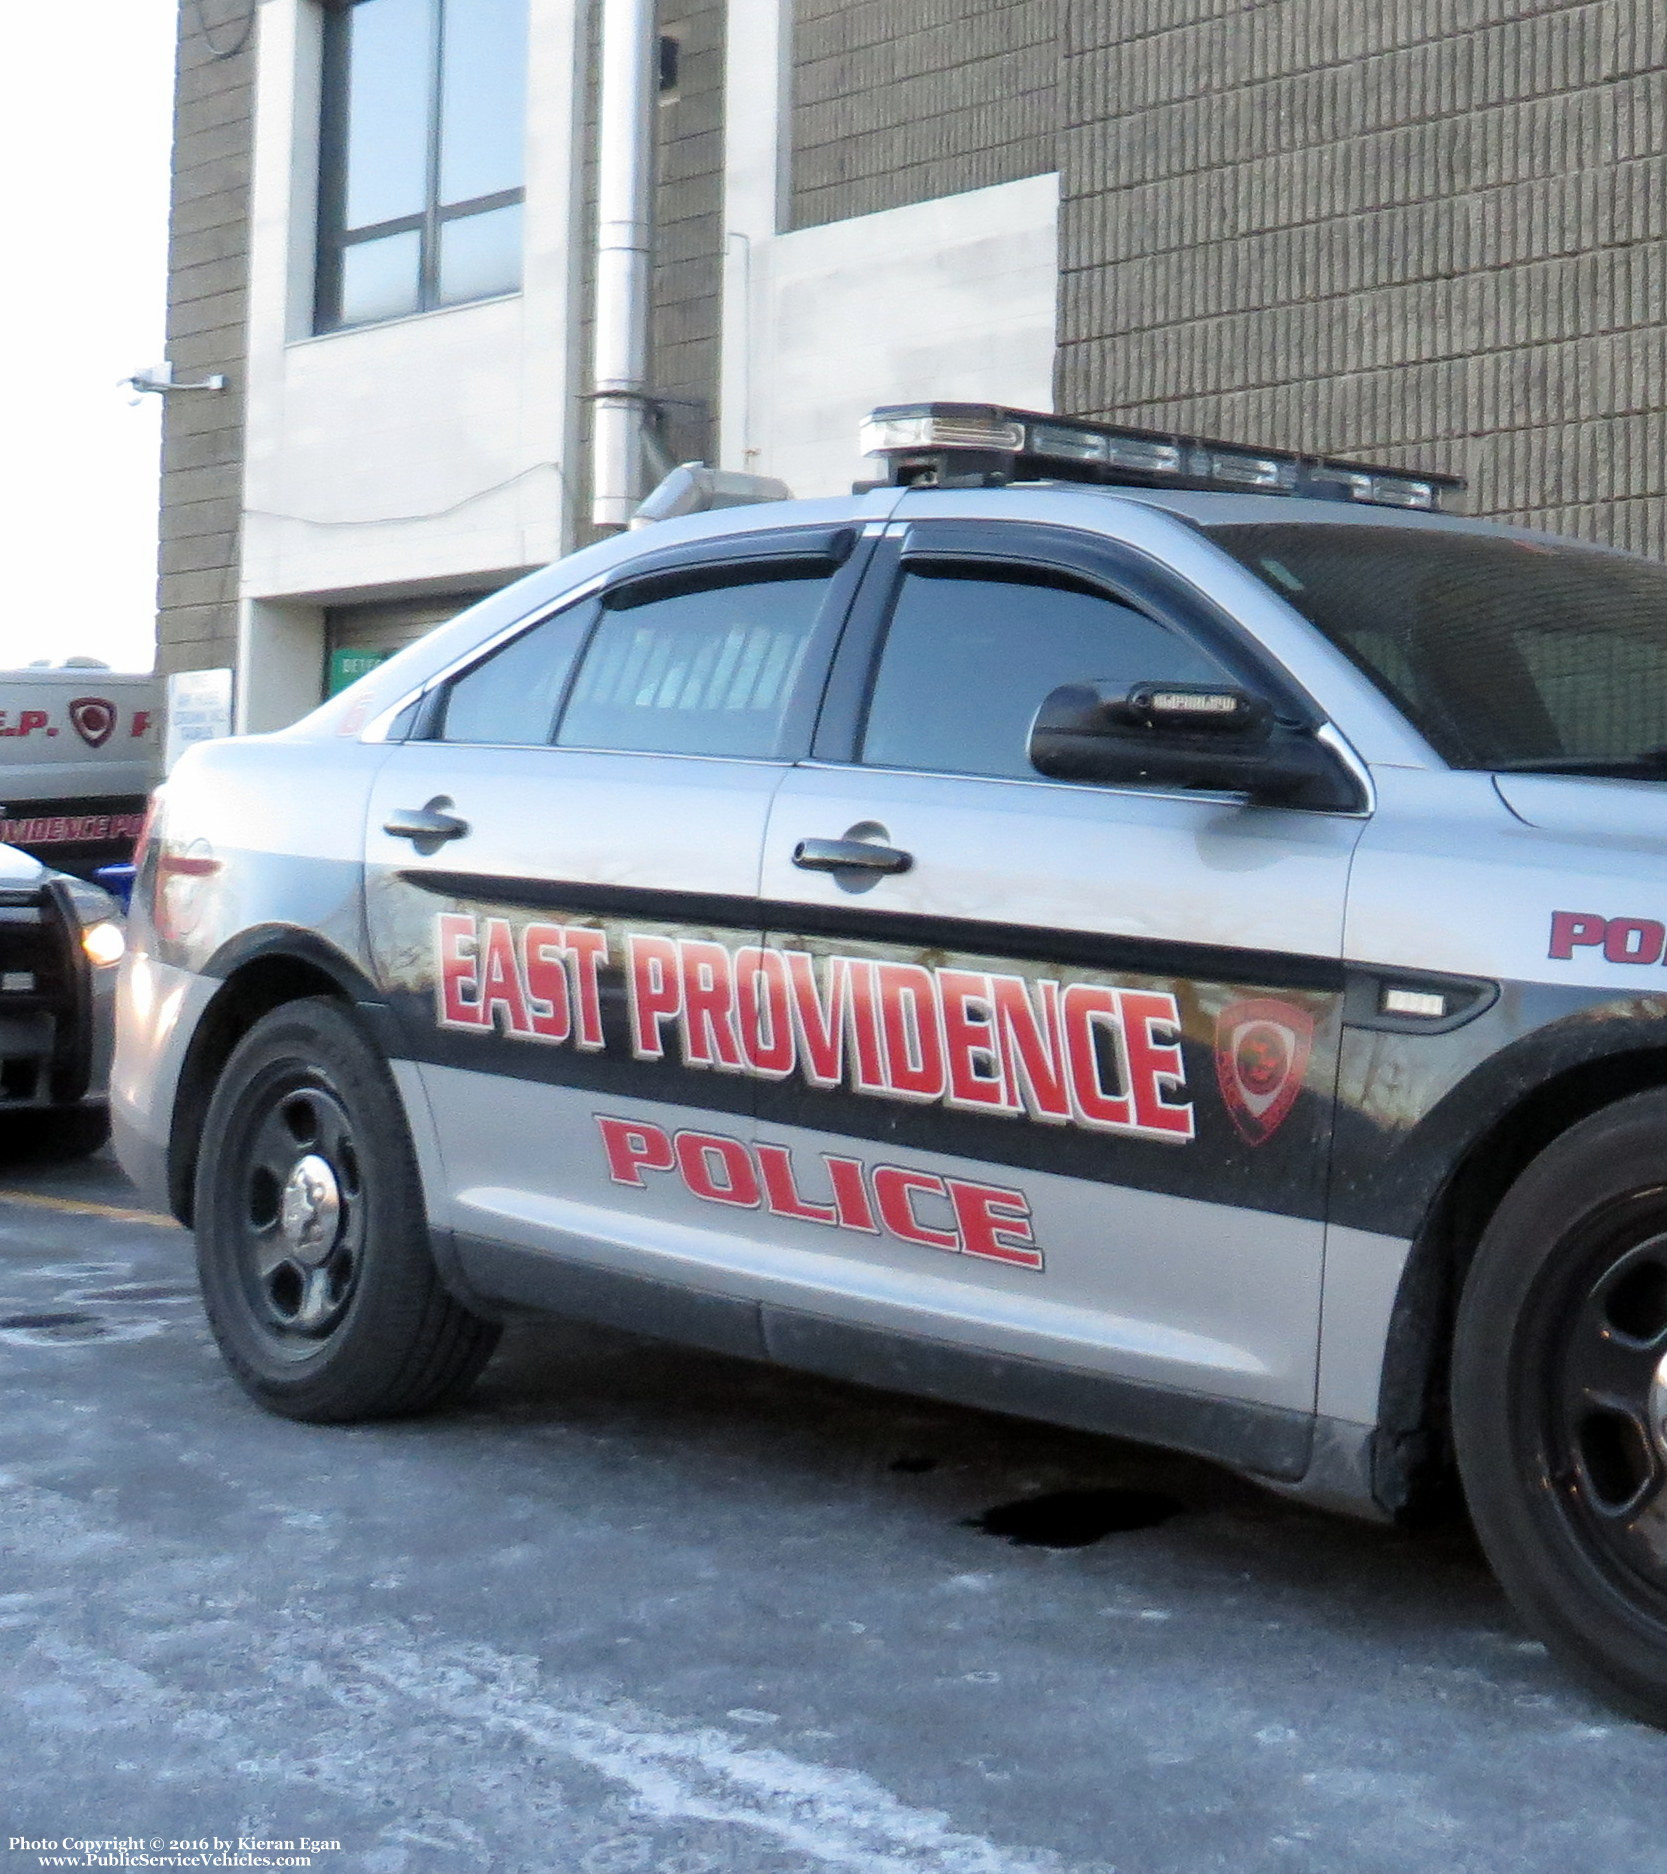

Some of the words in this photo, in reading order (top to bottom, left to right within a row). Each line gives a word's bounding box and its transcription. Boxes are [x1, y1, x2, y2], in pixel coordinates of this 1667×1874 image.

[435, 912, 608, 1053] EAST
[626, 931, 1195, 1145] PROVIDENCE
[591, 1112, 1045, 1273] POLICE
